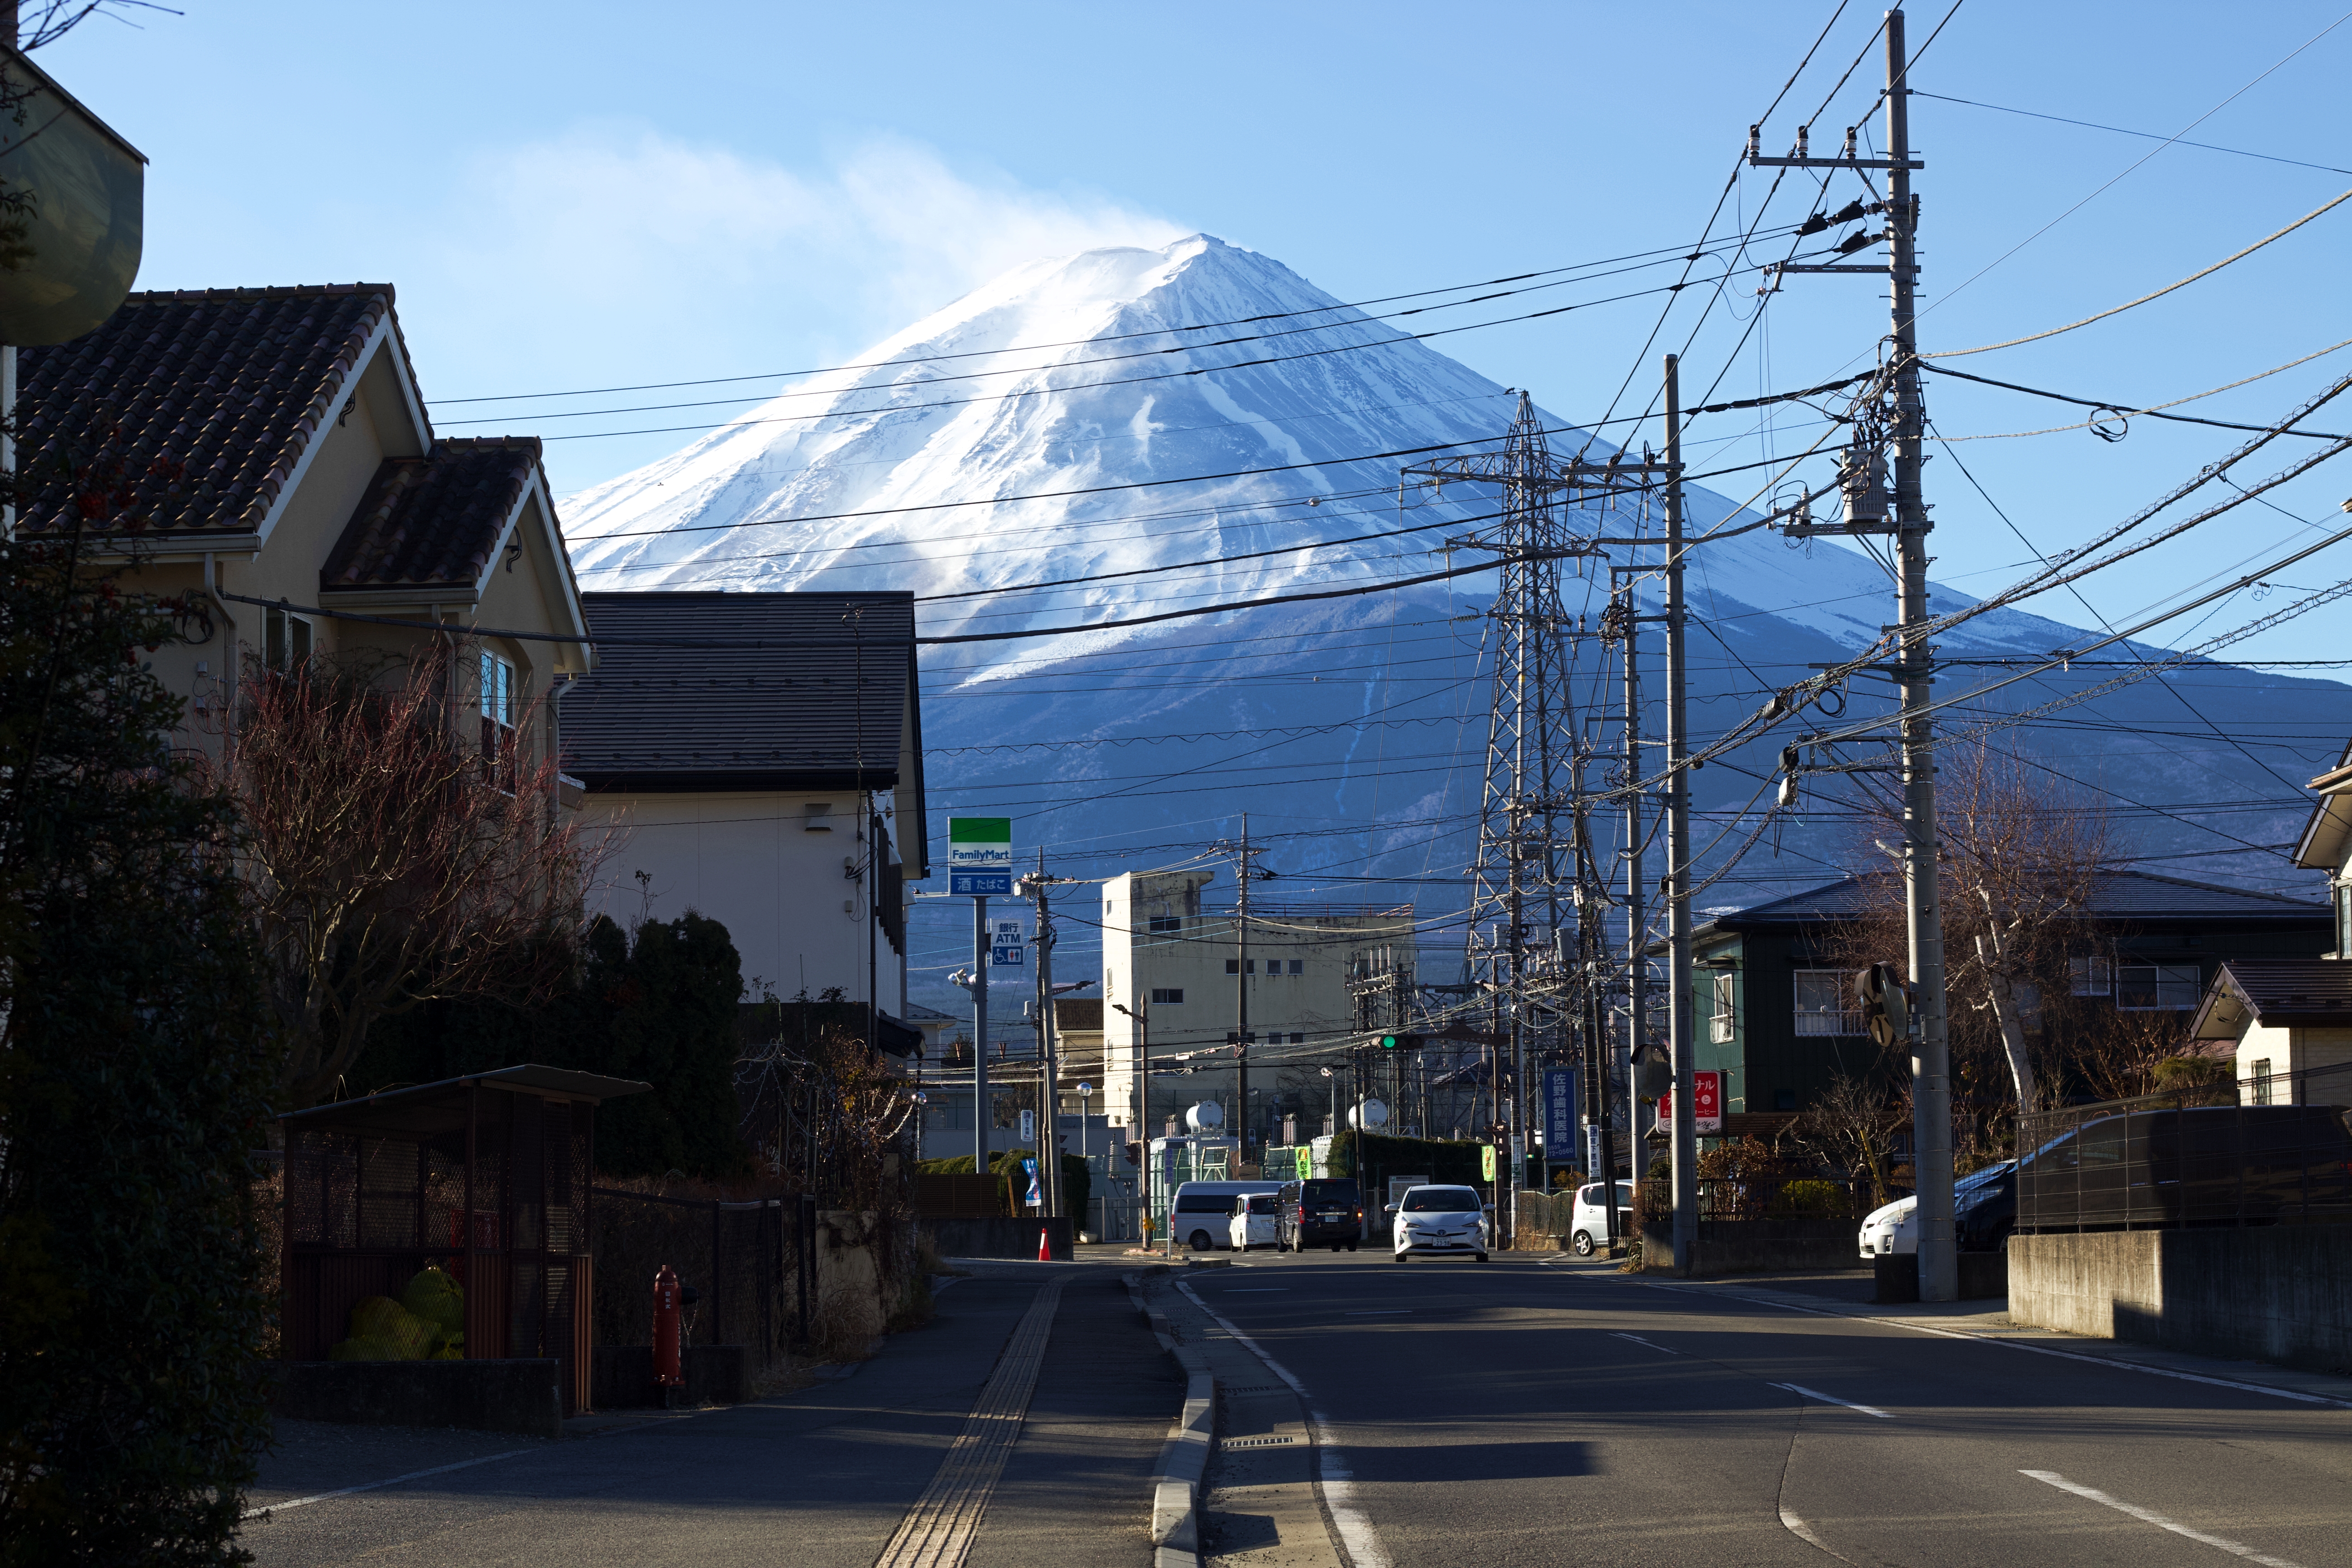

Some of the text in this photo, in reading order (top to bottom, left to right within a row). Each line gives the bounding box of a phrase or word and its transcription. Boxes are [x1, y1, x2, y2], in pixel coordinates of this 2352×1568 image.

[953, 850, 1009, 861] FamilyMart
[957, 877, 1005, 891] 酒 たばこ
[999, 923, 1018, 932] 銀行
[996, 934, 1020, 943] ATM
[1553, 1073, 1567, 1143] 佐野歯科医院
[1548, 1147, 1573, 1157] 72-0560
